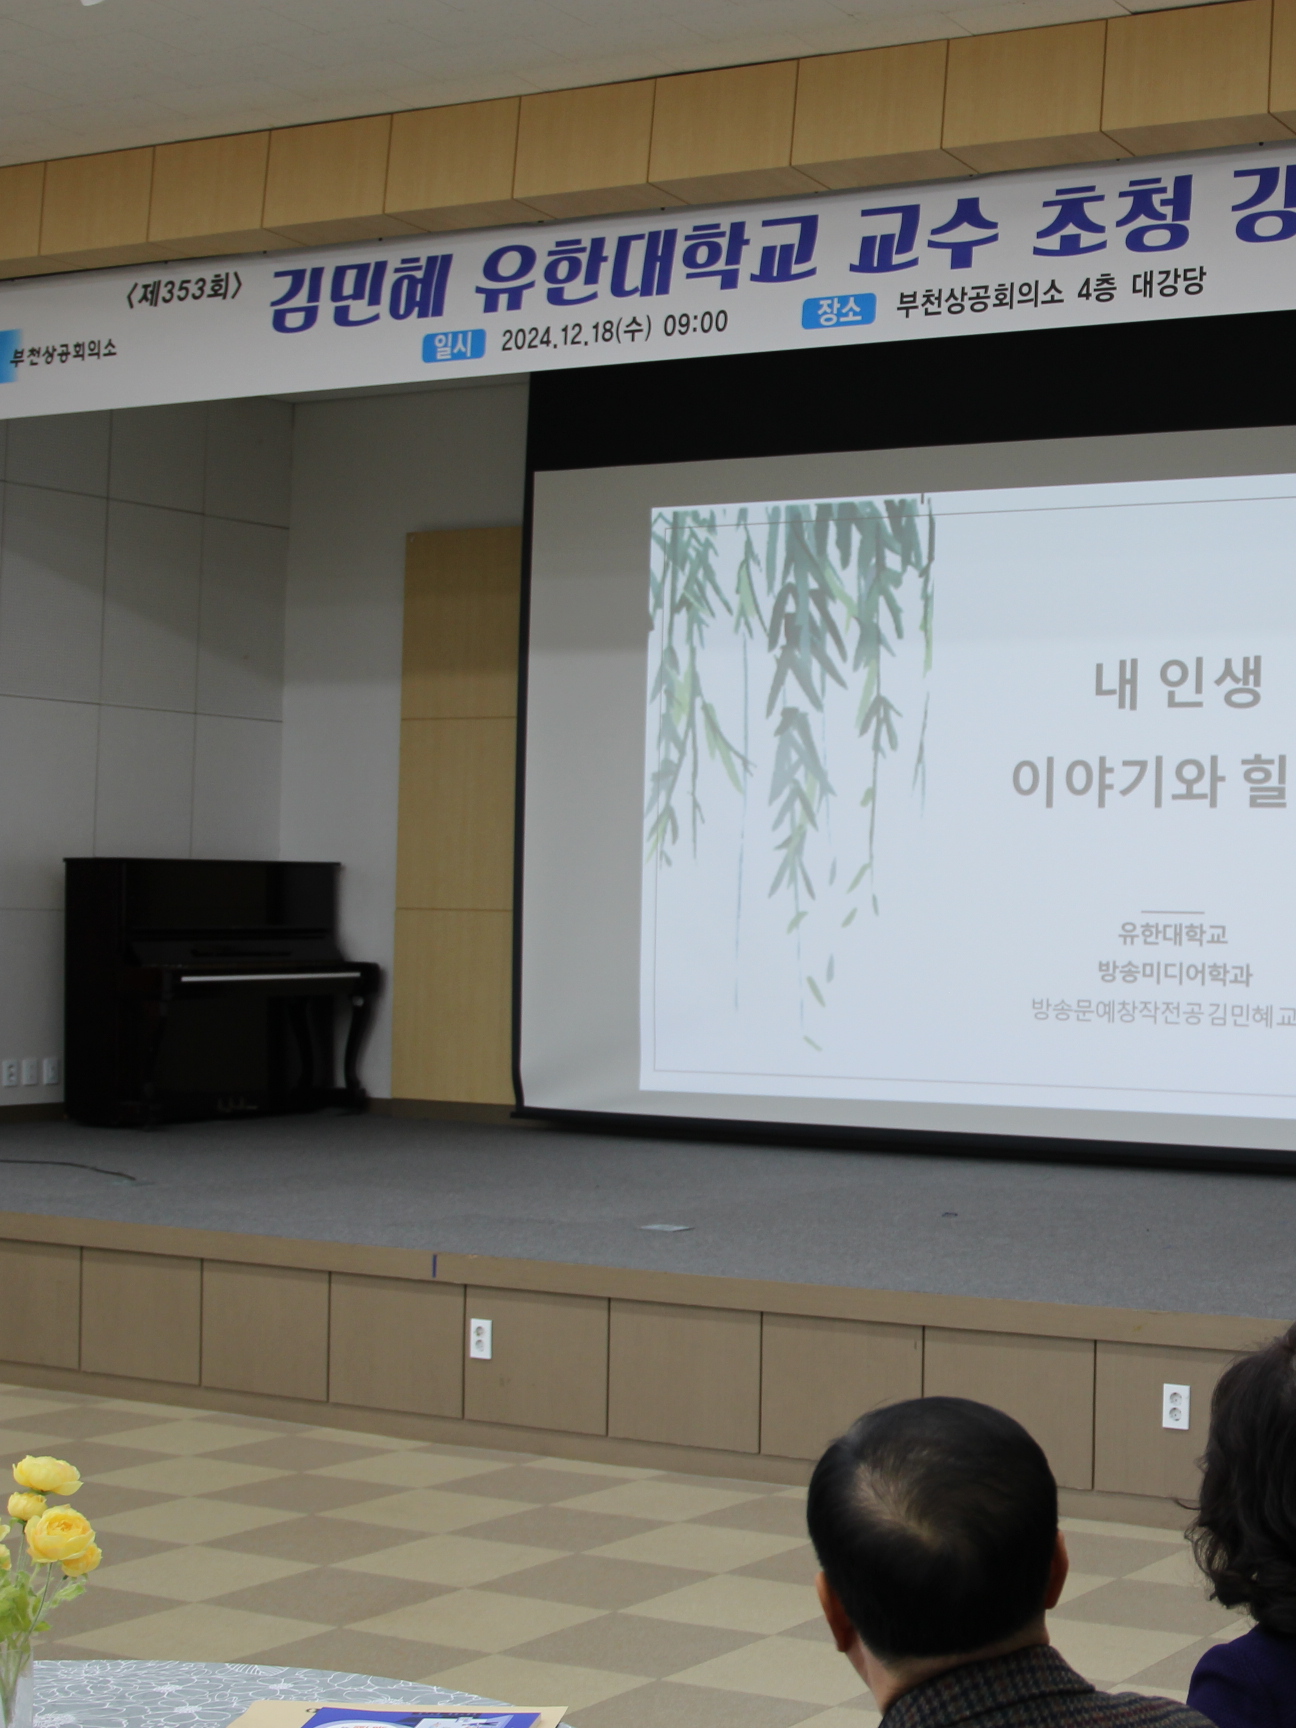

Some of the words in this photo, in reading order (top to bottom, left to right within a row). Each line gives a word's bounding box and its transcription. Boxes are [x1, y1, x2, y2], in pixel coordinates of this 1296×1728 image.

[270, 253, 453, 334] 김민혜
[474, 216, 817, 314] 유한대학교
[849, 197, 999, 270] 교수
[1032, 174, 1193, 257] 초청
[897, 279, 1064, 318] 부천상공회의소
[1078, 273, 1116, 302] 4층
[1133, 266, 1206, 298] 대강당
[817, 299, 863, 326] 장소
[434, 332, 472, 360] 일시
[502, 315, 651, 351] 2024.12.18(수)
[664, 310, 727, 336] 09:00
[10, 339, 116, 367] 부천상공회의소
[1096, 658, 1138, 710] 내
[1160, 656, 1261, 708] 인생
[1013, 755, 1225, 808] 이야기와
[1119, 922, 1228, 946] 유한대학교
[1099, 961, 1253, 987] 방송미디어학과
